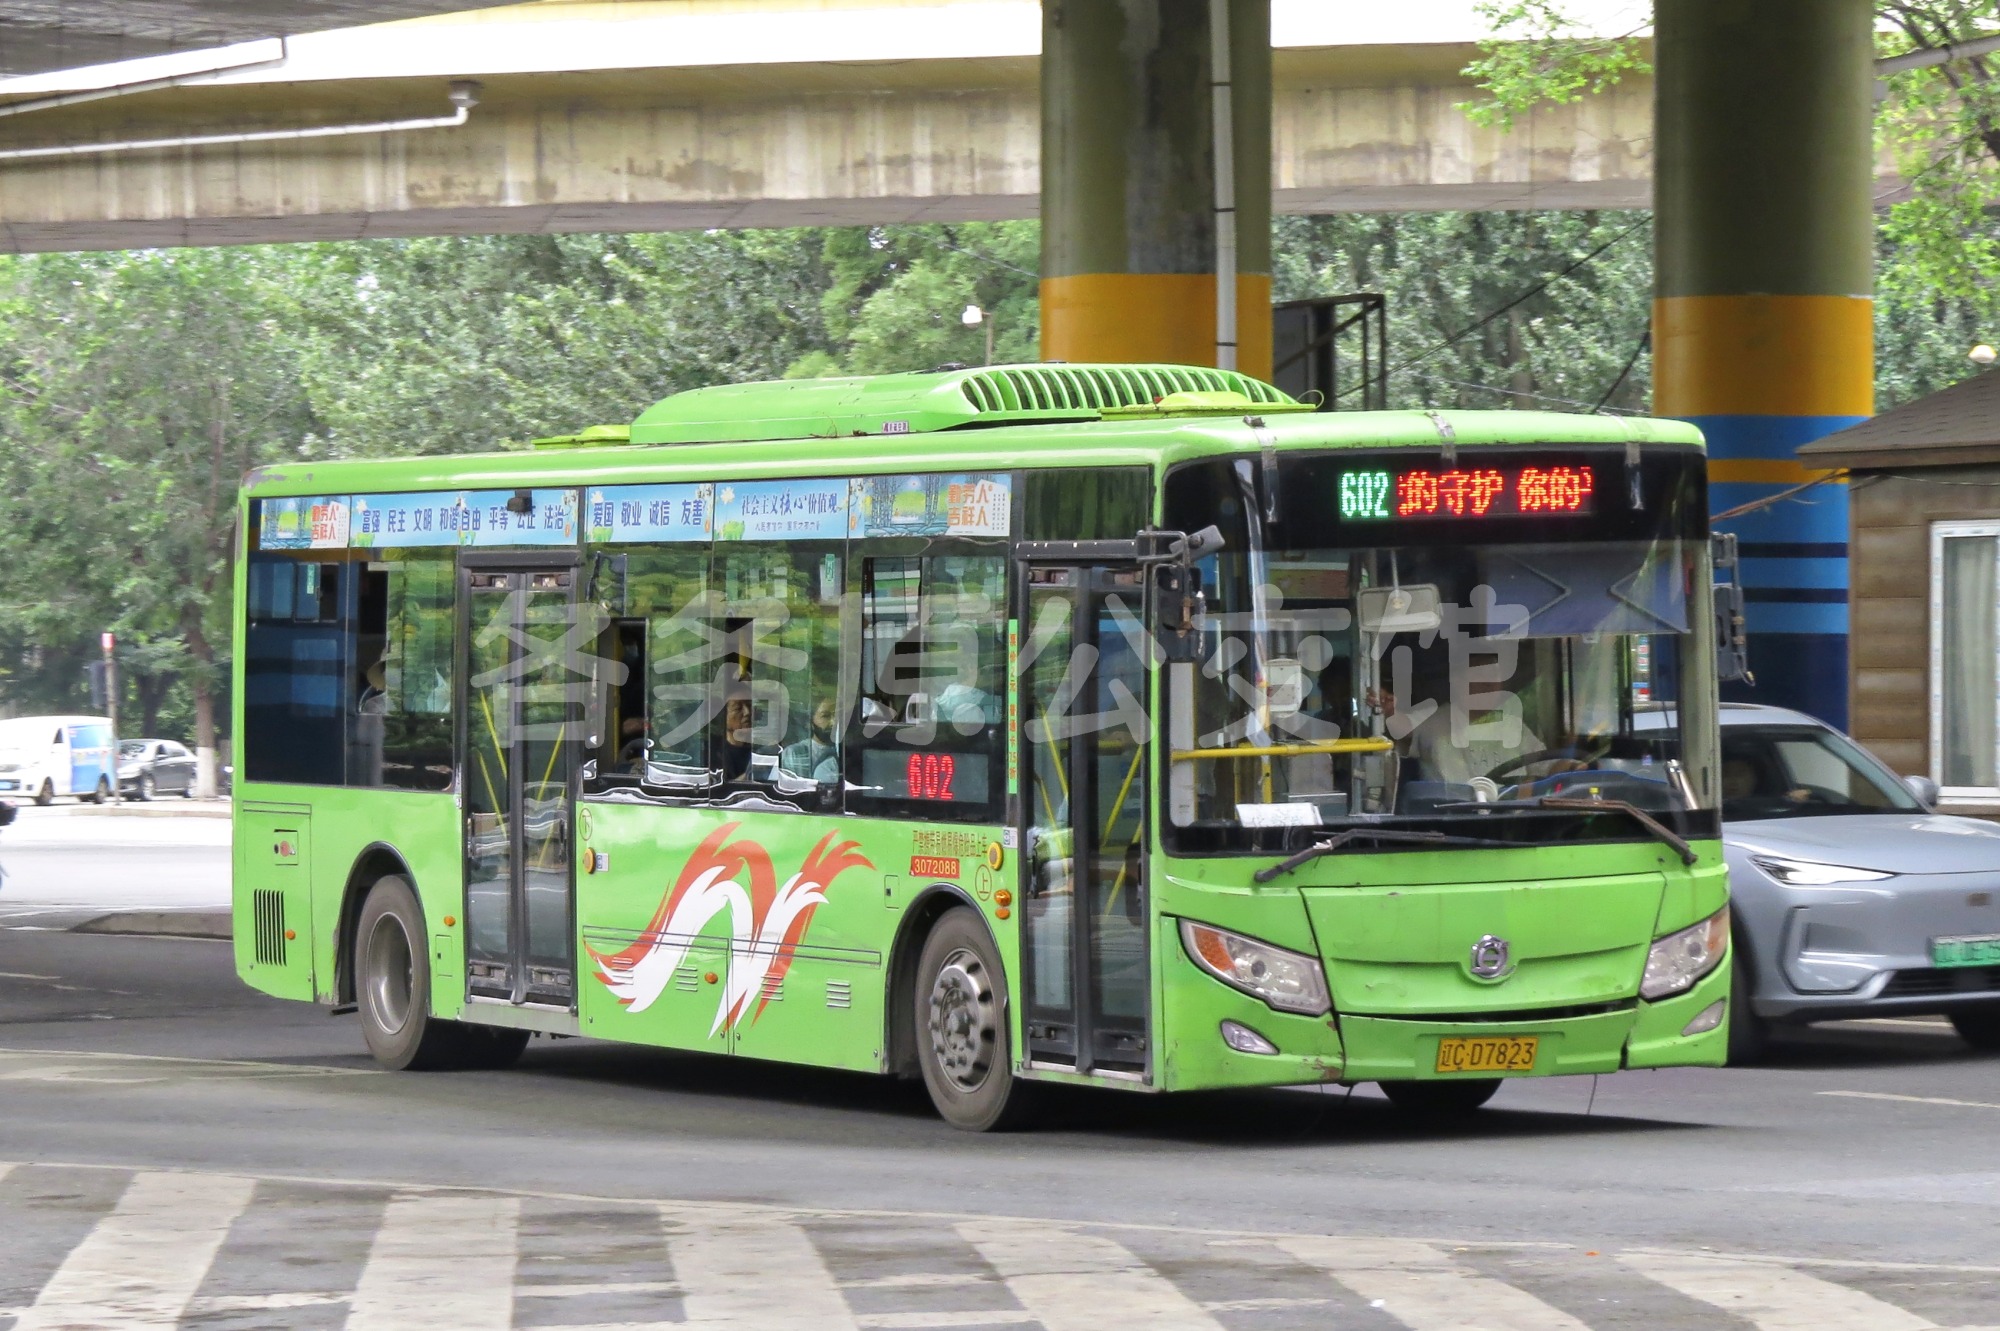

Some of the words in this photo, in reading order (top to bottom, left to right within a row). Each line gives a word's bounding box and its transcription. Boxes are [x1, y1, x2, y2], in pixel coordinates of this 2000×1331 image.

[742, 488, 838, 516] 社会主义核心价值观
[1340, 471, 1390, 517] 602
[362, 509, 381, 533] 富强
[388, 509, 406, 533] 民主
[413, 508, 433, 532] 文明
[440, 507, 459, 531] 和谐
[461, 507, 481, 531] 自由
[489, 506, 509, 531] 平等
[544, 504, 564, 530] 法治
[593, 501, 614, 527] 爱国
[621, 499, 642, 527] 敬业
[649, 499, 670, 526] 诚信
[681, 499, 703, 526] 友善
[948, 505, 989, 527] 吉祥人
[908, 753, 955, 800] 602
[914, 858, 958, 876] 3072088
